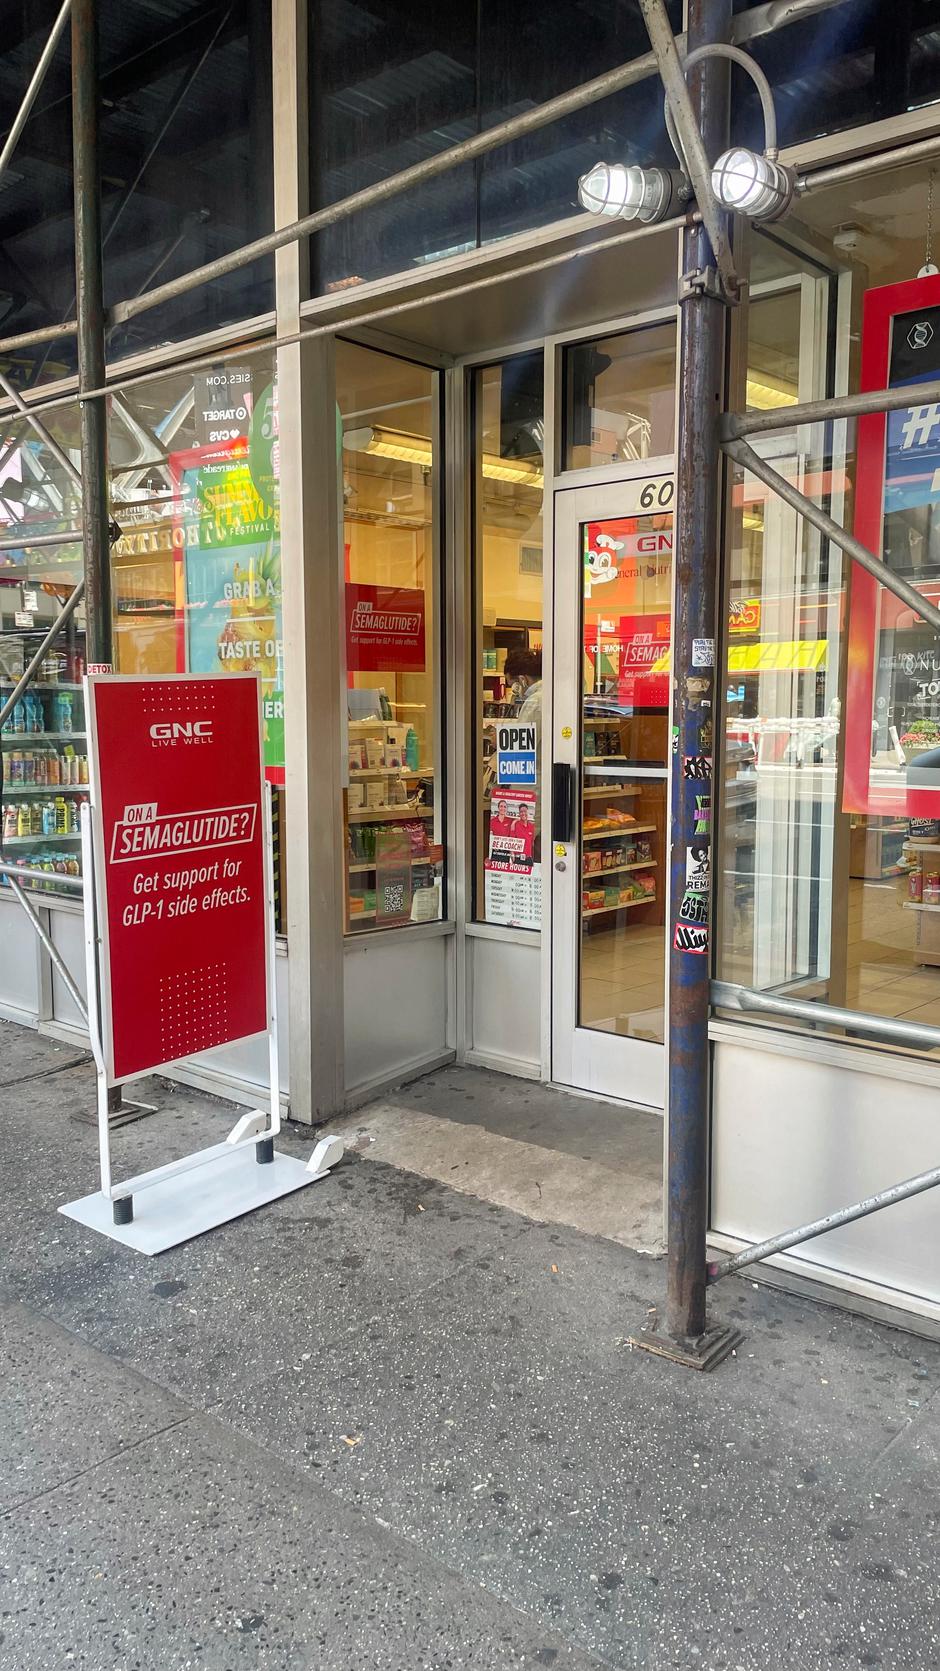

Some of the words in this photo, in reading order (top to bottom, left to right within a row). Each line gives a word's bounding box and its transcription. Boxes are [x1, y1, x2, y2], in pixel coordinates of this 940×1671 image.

[229, 522, 270, 536] FESTIVAL
[223, 579, 262, 600] GRAB
[265, 578, 276, 596] A
[358, 602, 366, 611] ON
[355, 613, 417, 631] SEMAGLUTIDE?
[218, 641, 261, 660] TASTE
[88, 664, 112, 674] DETOX
[149, 721, 213, 739] GNC
[151, 738, 177, 748] LIVE
[183, 736, 214, 746] WELL
[499, 728, 535, 751] OPEN
[500, 760, 527, 775] COME
[526, 760, 535, 775] IN
[127, 808, 143, 823] ON
[146, 806, 153, 820] A
[119, 811, 250, 854] SEMAGLUTIDE?
[492, 840, 500, 849] BE
[491, 860, 508, 871] STORE
[509, 862, 530, 873] HOURS
[133, 872, 159, 895] Get
[163, 861, 219, 892] support
[222, 858, 242, 879] for
[122, 899, 163, 927] GLP-1
[167, 895, 197, 918] side
[202, 884, 251, 911] effects.
